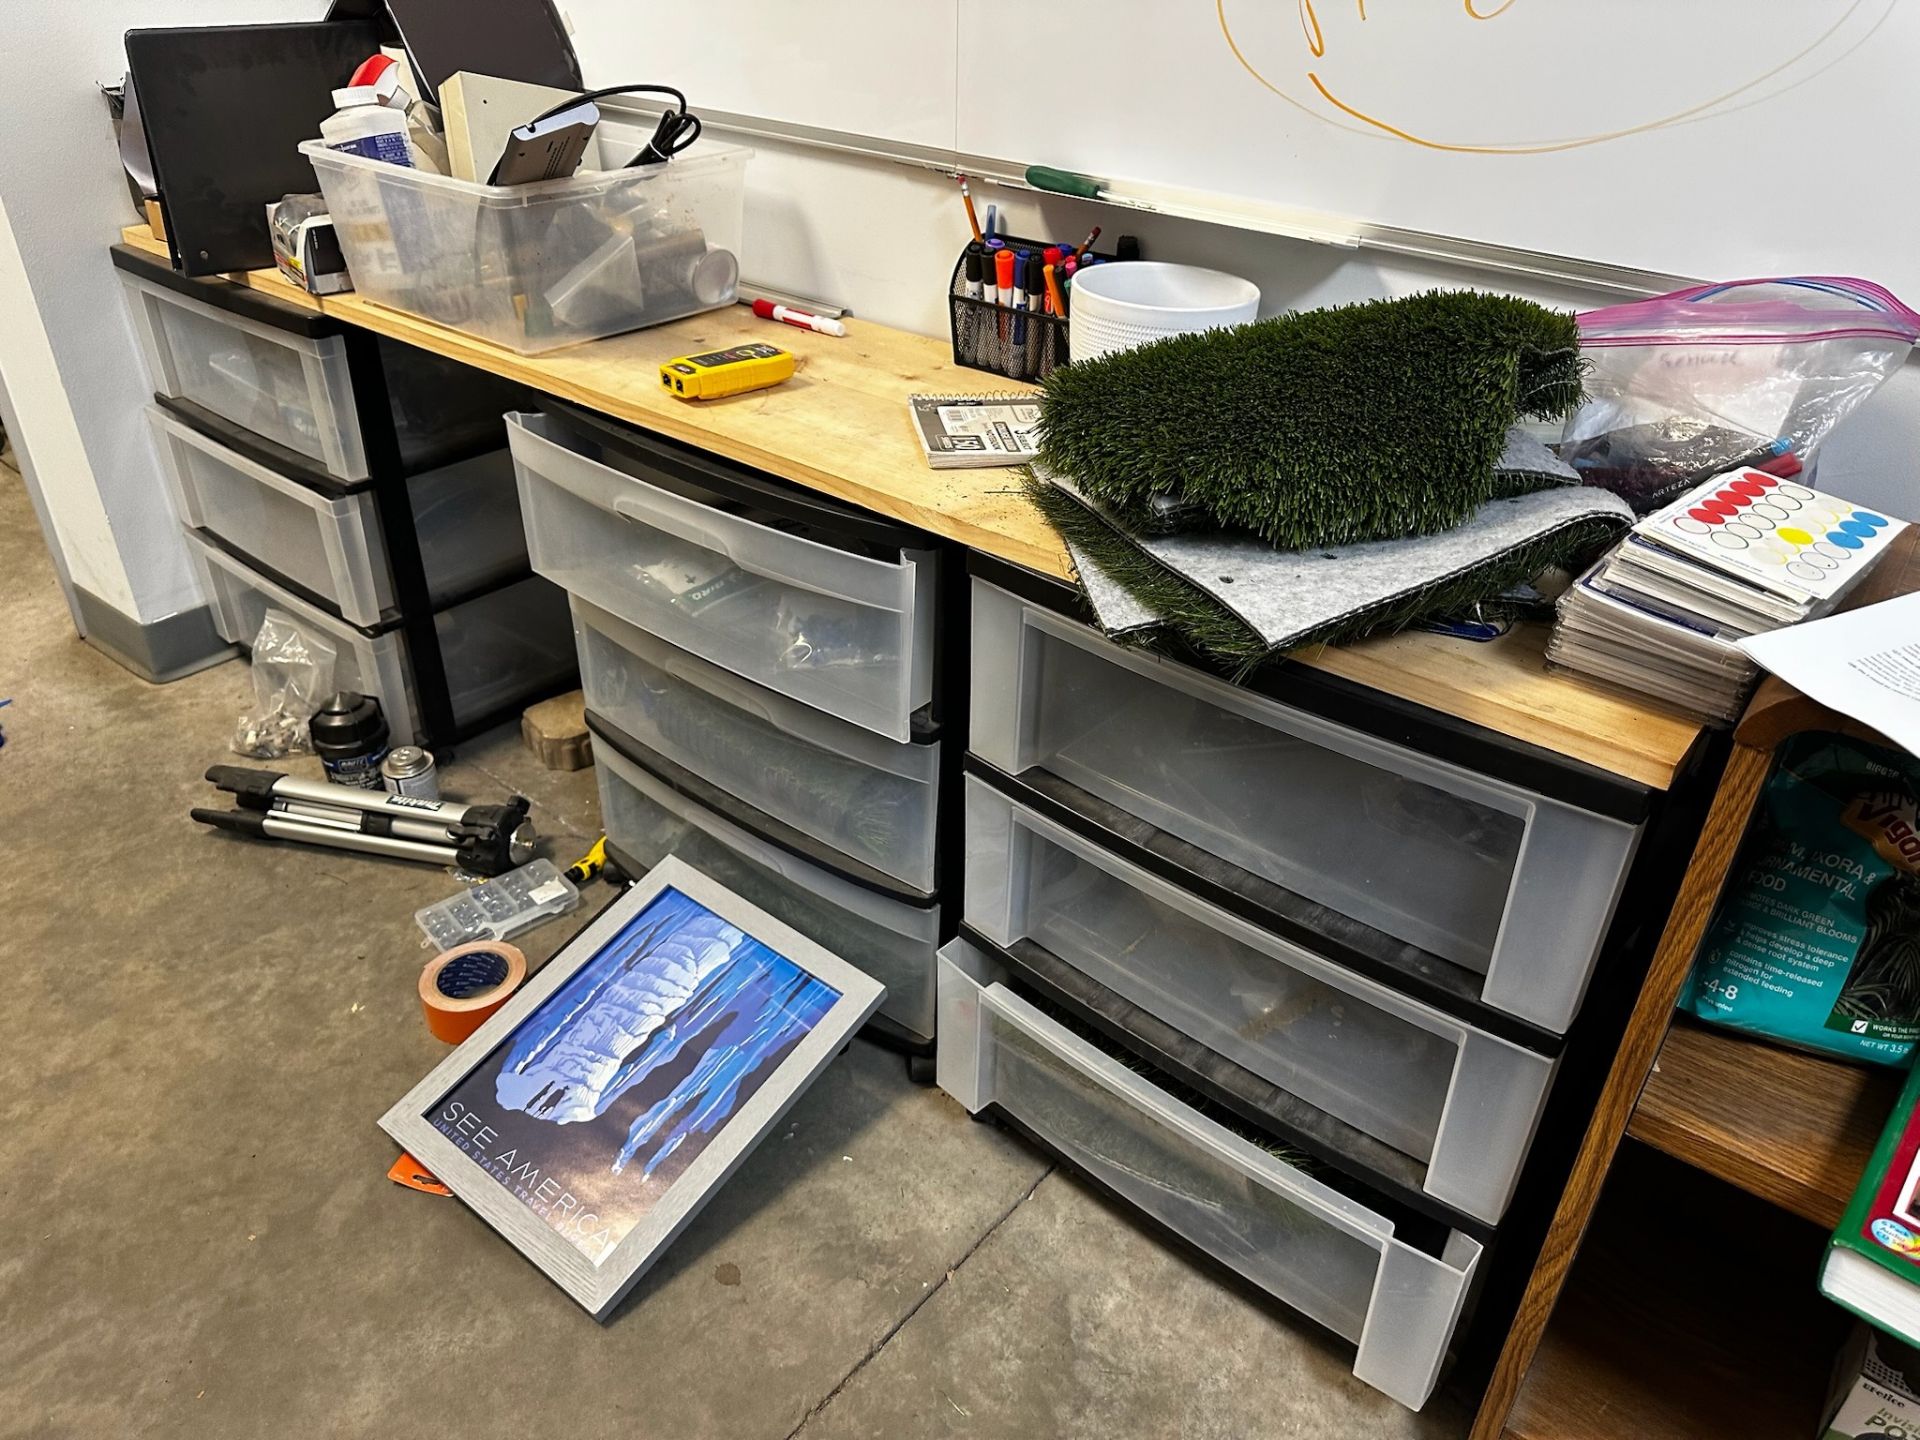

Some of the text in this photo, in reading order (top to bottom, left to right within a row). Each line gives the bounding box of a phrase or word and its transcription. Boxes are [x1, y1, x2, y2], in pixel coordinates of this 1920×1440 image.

[1652, 477, 1691, 499] ARTEZA
[1812, 850, 1877, 886] IXORA &
[1769, 908, 1815, 930] BRILLIANT
[1816, 925, 1858, 944] BLOOMS
[1777, 901, 1799, 915] DARK
[1801, 911, 1835, 928] GREEN
[1743, 938, 1767, 954] dense
[1768, 947, 1787, 961] root
[1787, 954, 1820, 973] system
[1768, 939, 1803, 959] develop
[1812, 953, 1835, 968] deep
[1778, 934, 1806, 950] stress
[1807, 944, 1849, 963] tolerance
[1723, 965, 1794, 998] extended feeding
[1726, 957, 1773, 981] nitrogen for
[1729, 949, 1824, 988] contains time-released
[1704, 977, 1739, 1001] -4-8
[1872, 1023, 1897, 1034] WORKS
[1859, 1038, 1876, 1049] NET
[1877, 1041, 1888, 1051] WT
[1889, 1043, 1903, 1054] 3.5
[433, 1118, 471, 1151] UNITED
[472, 1151, 511, 1185] STATES
[513, 1185, 552, 1222] TRAVEL
[443, 1102, 611, 1250] SEE AMERICA
[1877, 1407, 1920, 1435] Invisi
